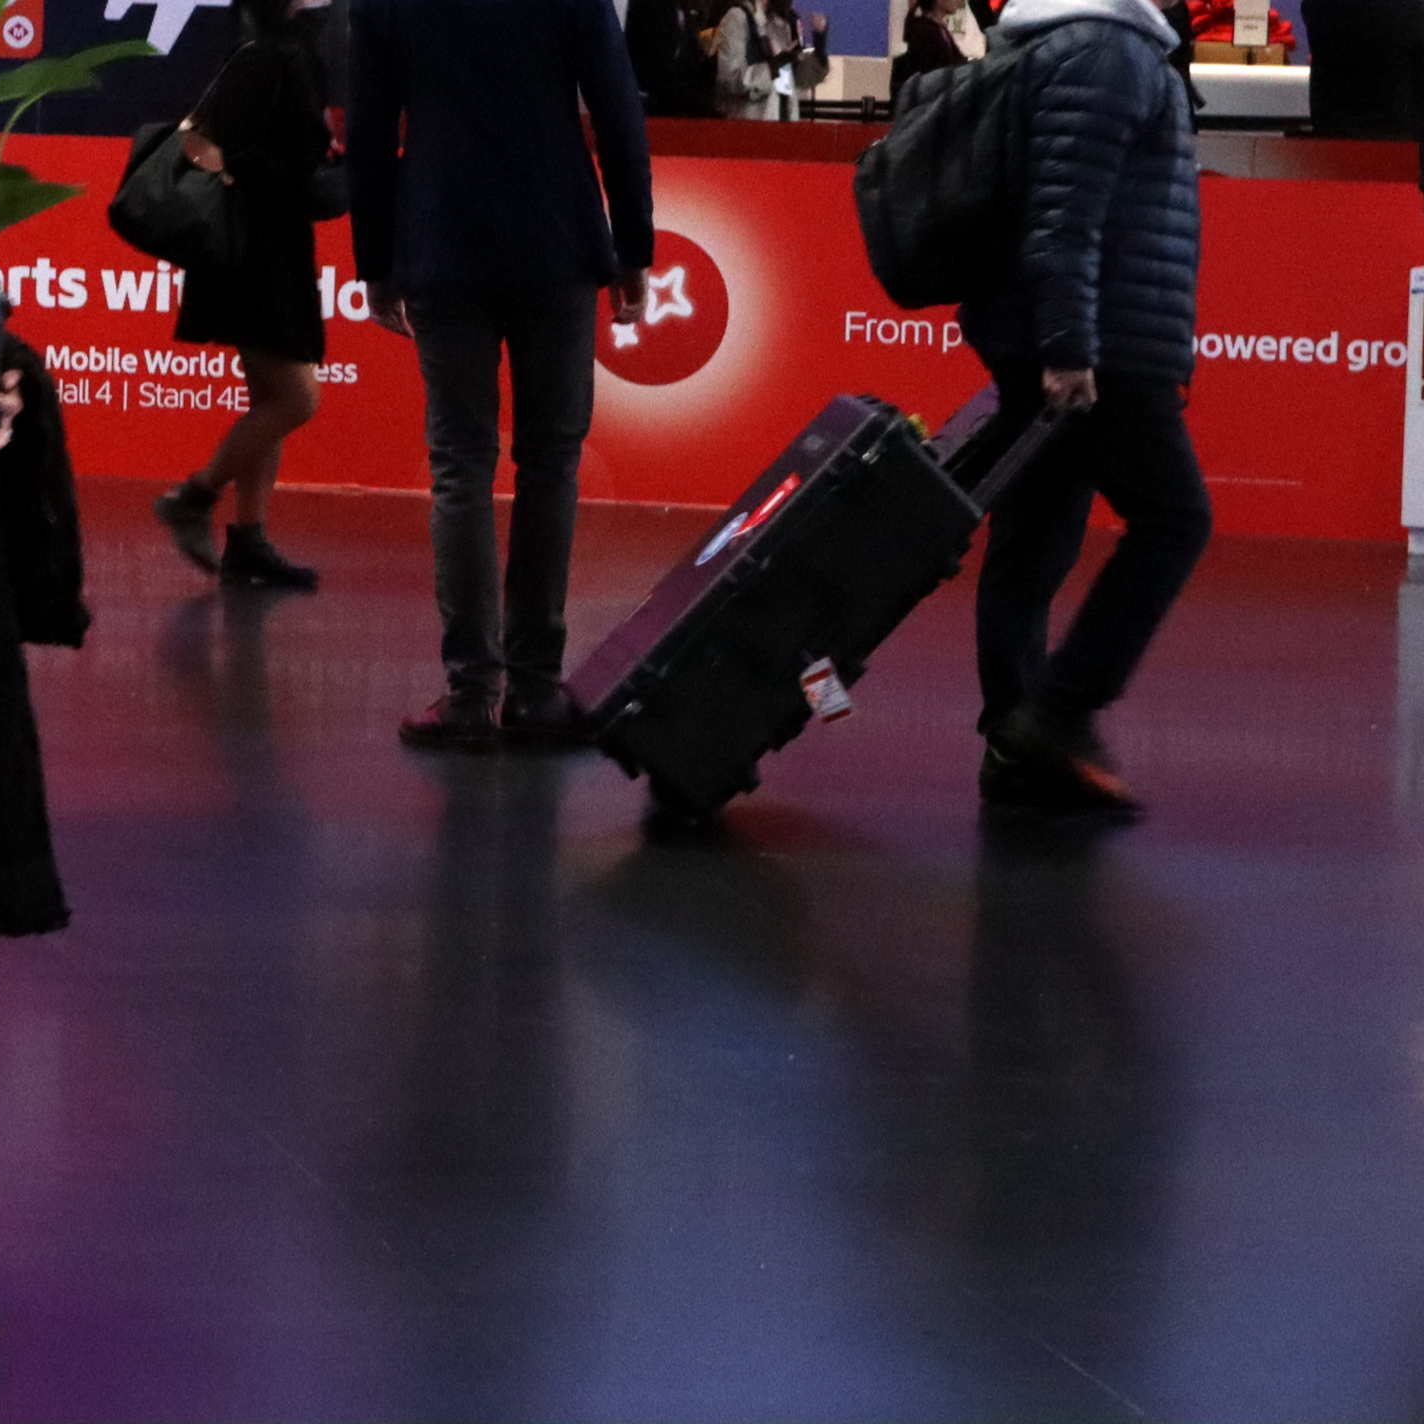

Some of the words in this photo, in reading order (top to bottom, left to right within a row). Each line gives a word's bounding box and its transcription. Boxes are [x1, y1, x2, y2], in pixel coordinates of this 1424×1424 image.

[845, 311, 933, 345] From
[44, 345, 138, 374] Mobile
[144, 350, 225, 377] World
[1347, 339, 1408, 372] gro
[95, 382, 113, 404] 4
[139, 382, 211, 410] Stand
[216, 384, 250, 412] 4E
